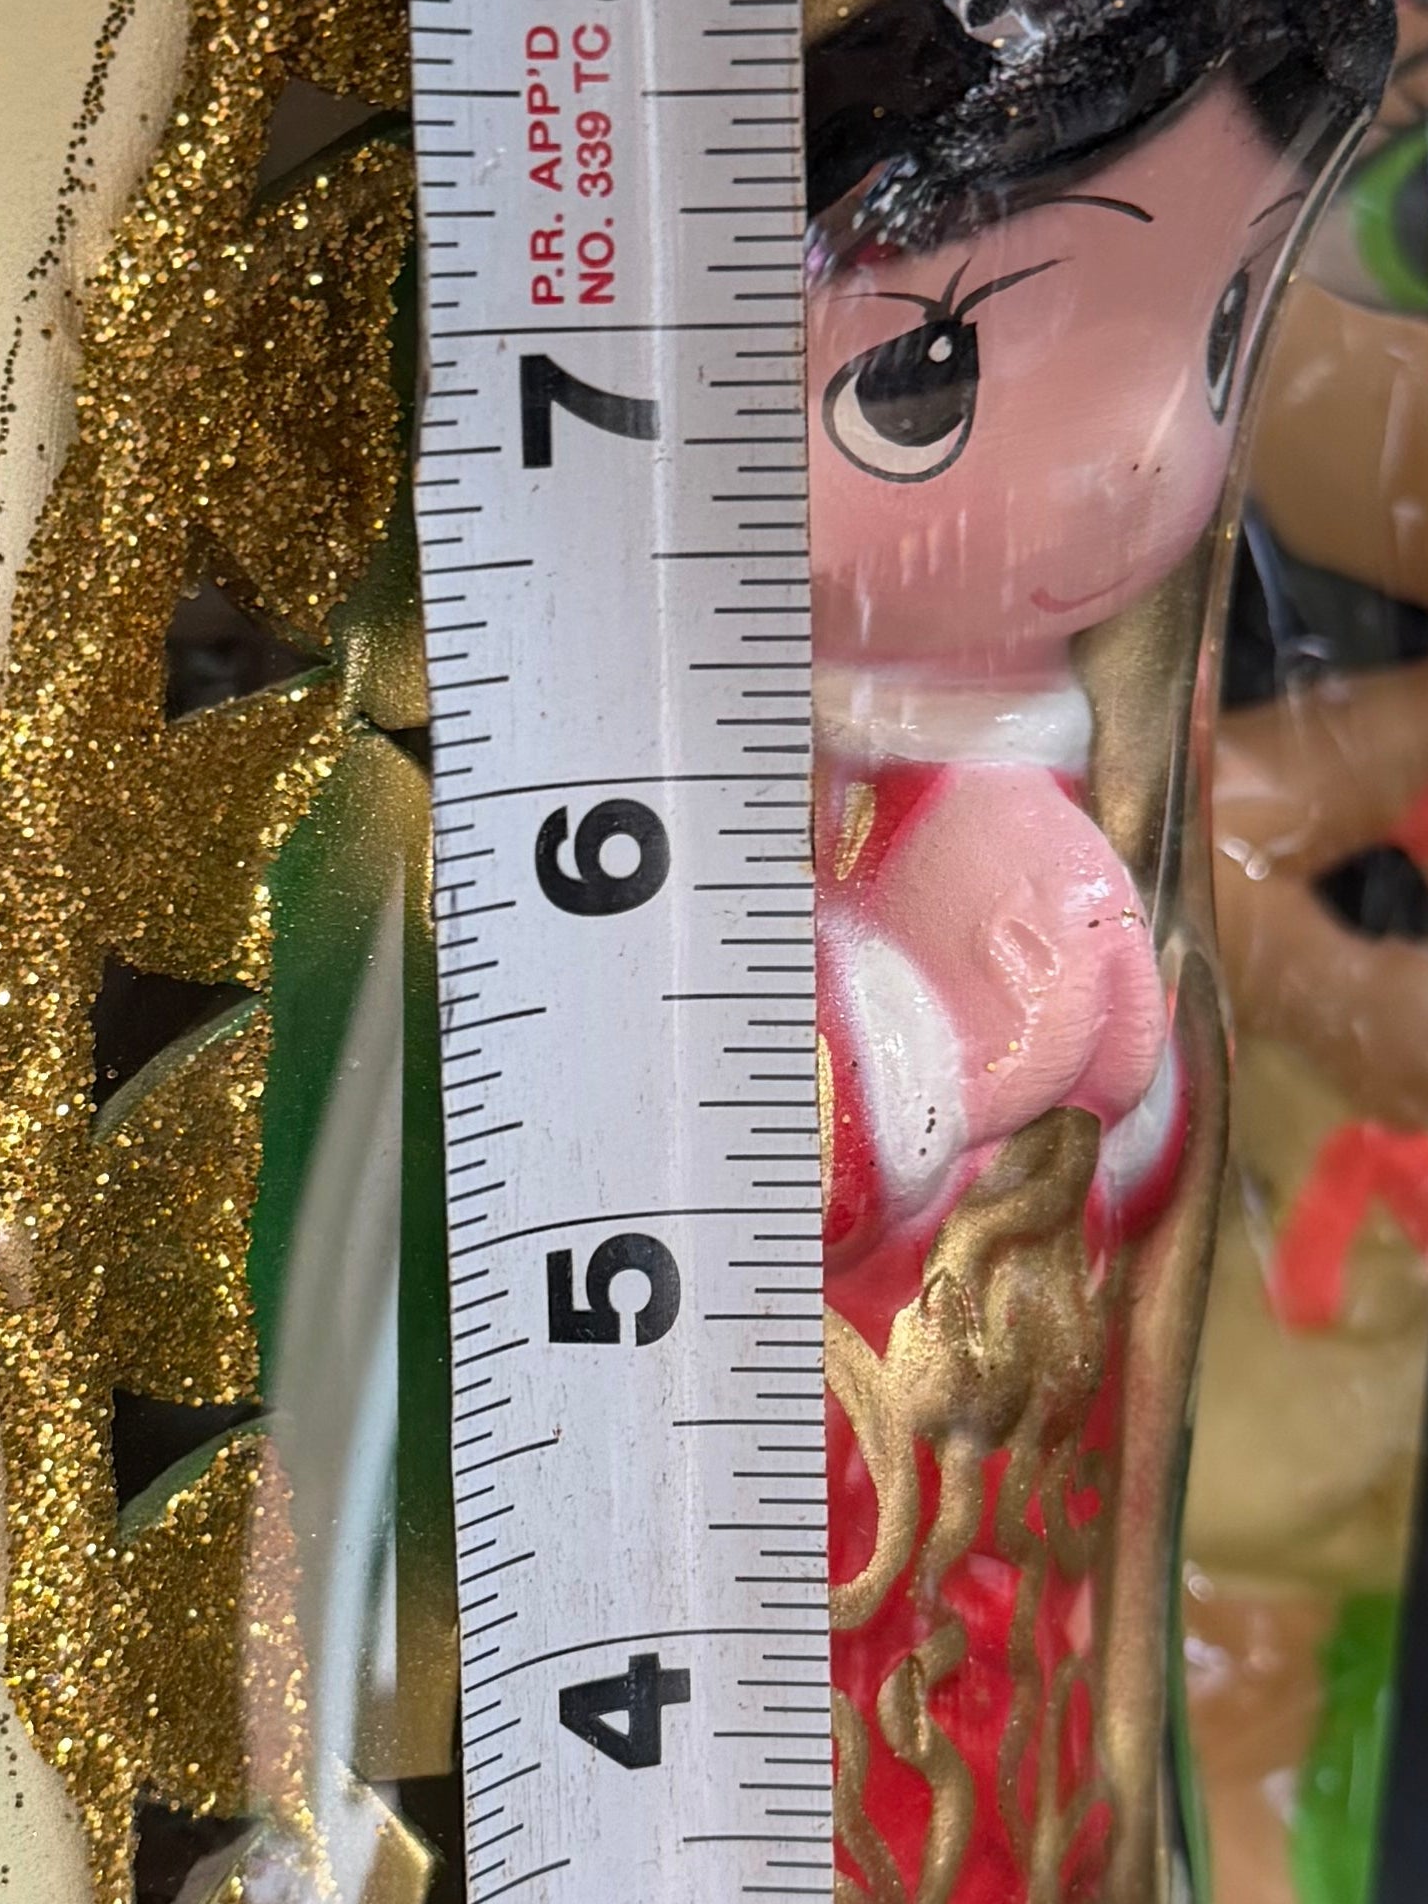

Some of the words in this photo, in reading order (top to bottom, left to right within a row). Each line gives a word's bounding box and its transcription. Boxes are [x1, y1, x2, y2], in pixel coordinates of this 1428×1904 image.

[525, 25, 563, 192] APP'D
[572, 23, 612, 94] TC
[575, 110, 614, 198] 339
[530, 213, 565, 305] P.R.
[576, 217, 616, 305] NO.
[519, 353, 662, 468] 7
[534, 798, 671, 917] 6
[546, 1232, 682, 1347] 5
[559, 1652, 691, 1770] 4
